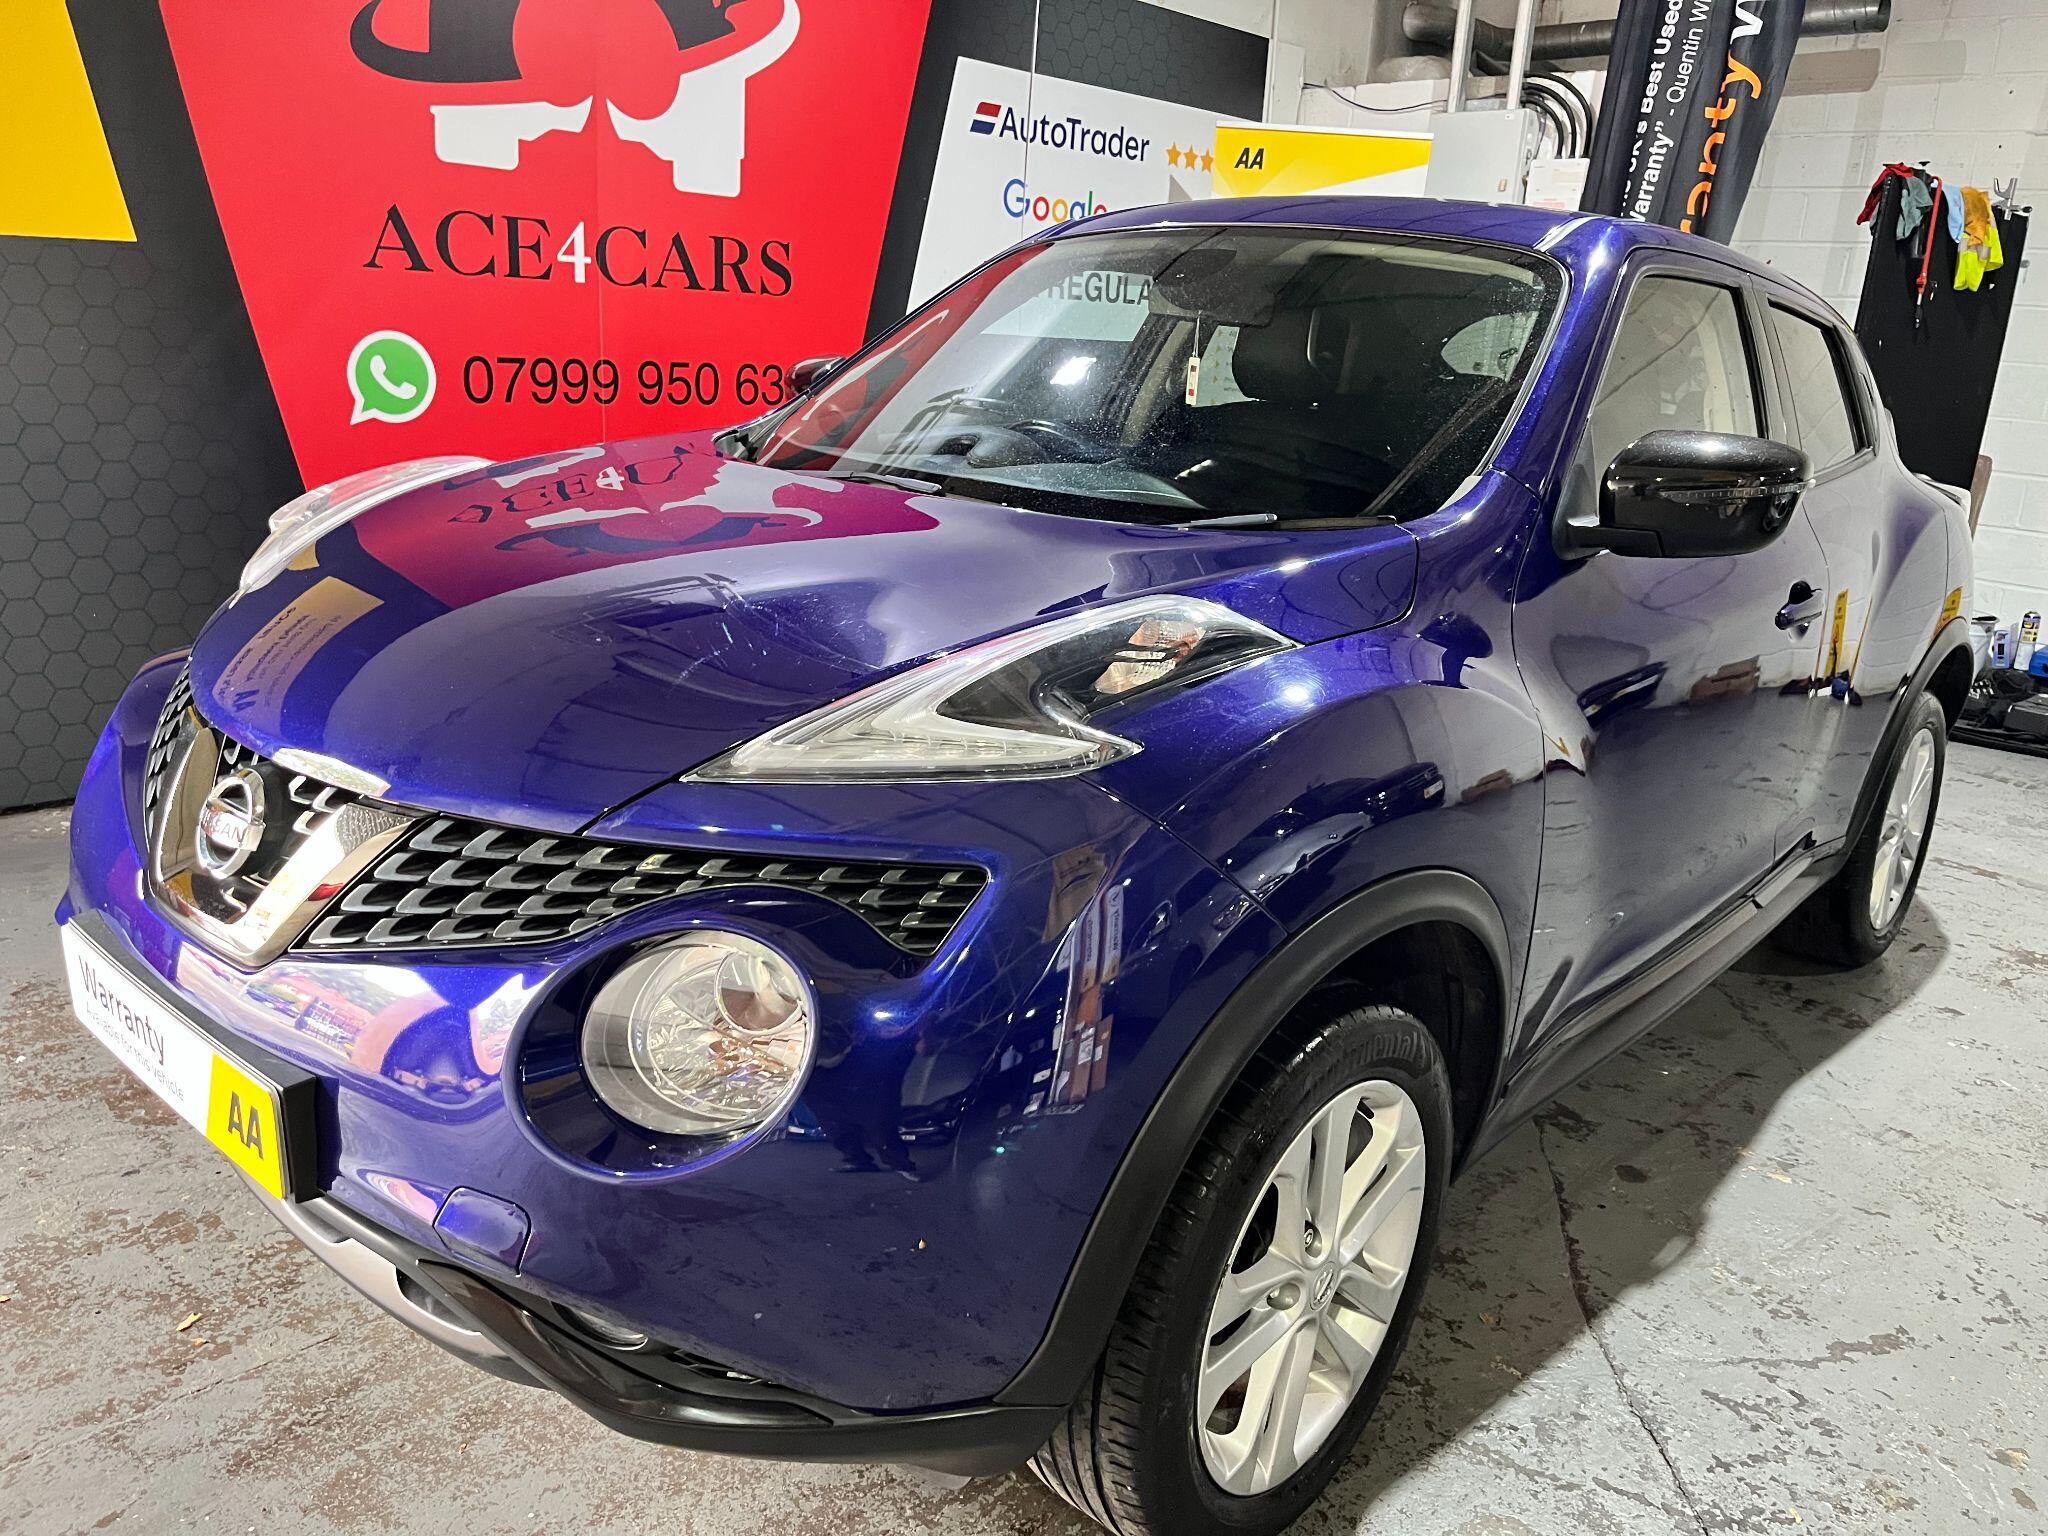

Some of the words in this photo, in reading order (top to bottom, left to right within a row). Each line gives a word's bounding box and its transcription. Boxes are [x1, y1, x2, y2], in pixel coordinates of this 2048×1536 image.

[1641, 62, 1665, 114] Best
[1667, 29, 1703, 103] Quentin
[999, 107, 1149, 161] AutoTrader
[1234, 147, 1264, 170] AA
[362, 203, 792, 296] ACE4CARS
[463, 356, 619, 404] 07999
[637, 362, 720, 405] 950
[79, 955, 164, 1066] Warranty
[228, 1090, 264, 1161] AA
